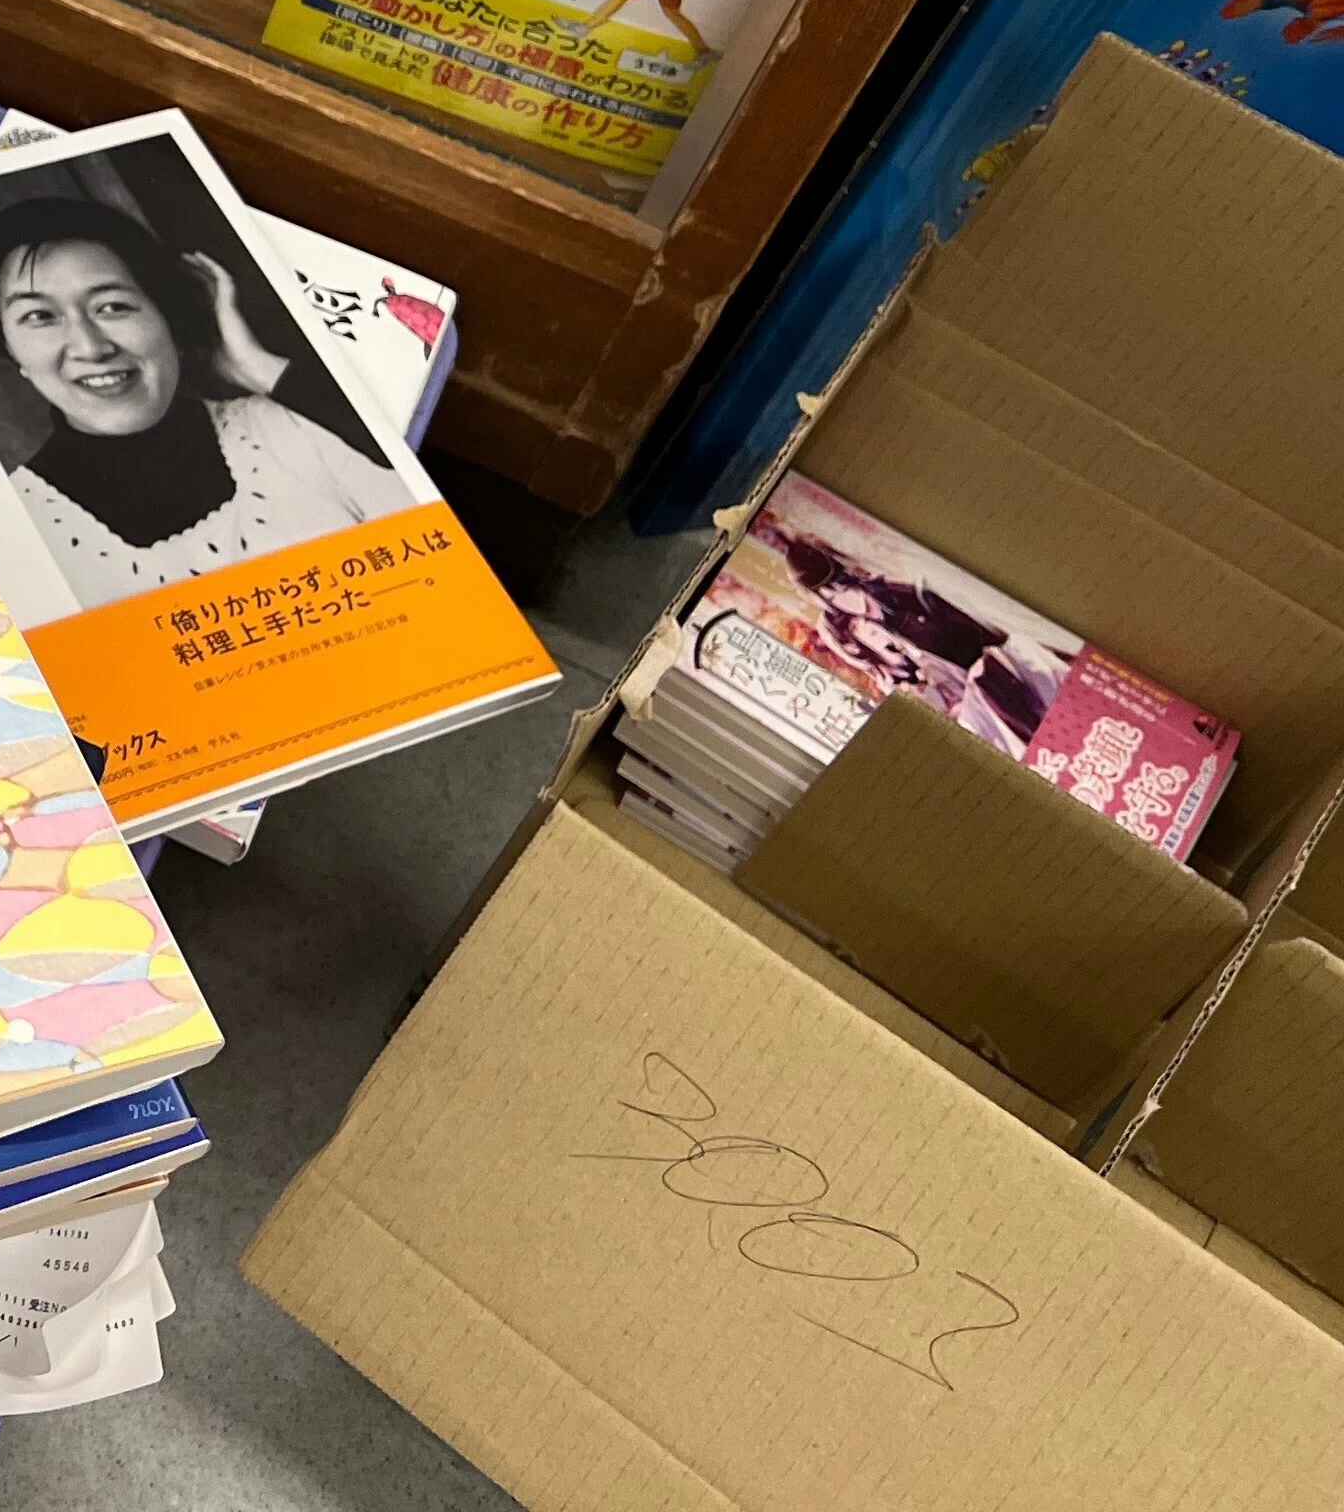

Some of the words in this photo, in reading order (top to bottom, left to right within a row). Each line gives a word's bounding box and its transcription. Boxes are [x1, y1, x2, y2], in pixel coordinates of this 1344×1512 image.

[153, 529, 453, 636] 「倚りかからず」の詩人は
